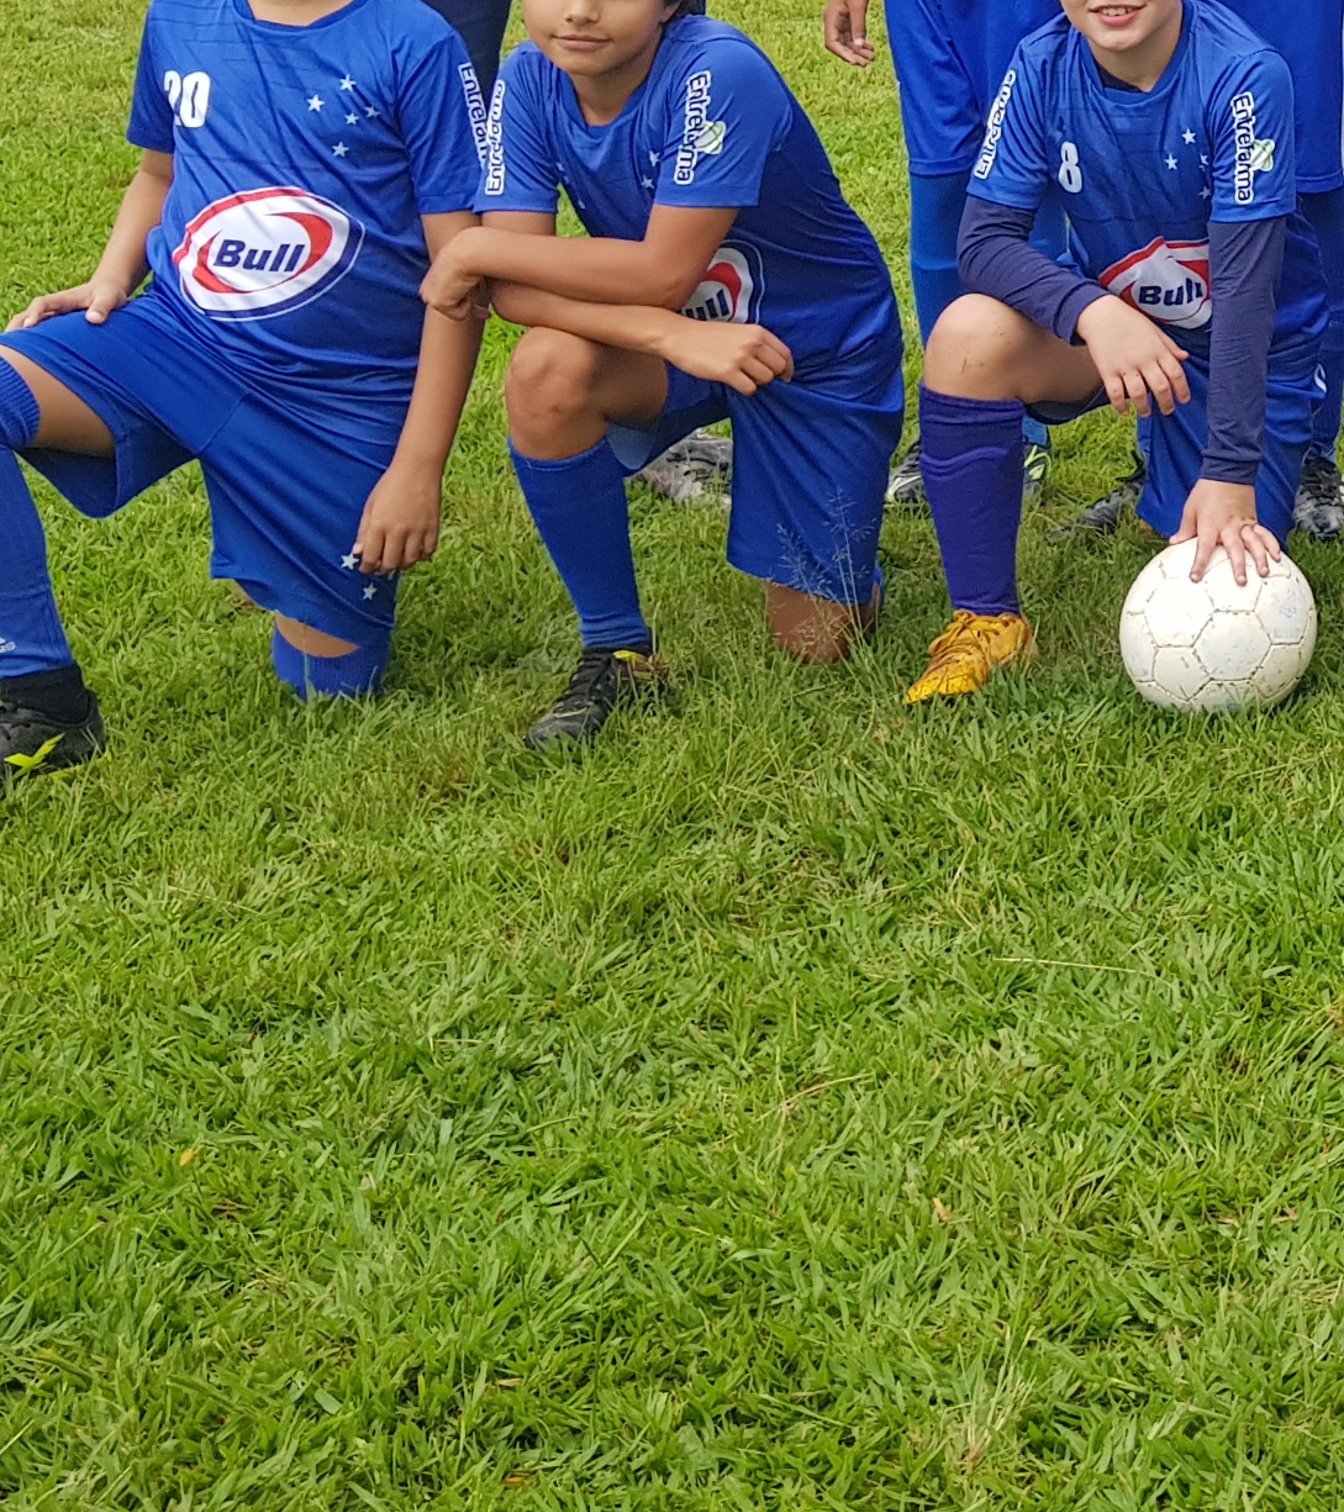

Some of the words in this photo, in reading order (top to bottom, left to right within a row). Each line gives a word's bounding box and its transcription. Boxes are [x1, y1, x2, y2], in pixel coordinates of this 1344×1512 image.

[163, 70, 211, 128] 20
[1058, 141, 1083, 194] 8
[1231, 92, 1254, 204] Entrefarma
[213, 238, 306, 273] Bull
[677, 288, 730, 321] ull
